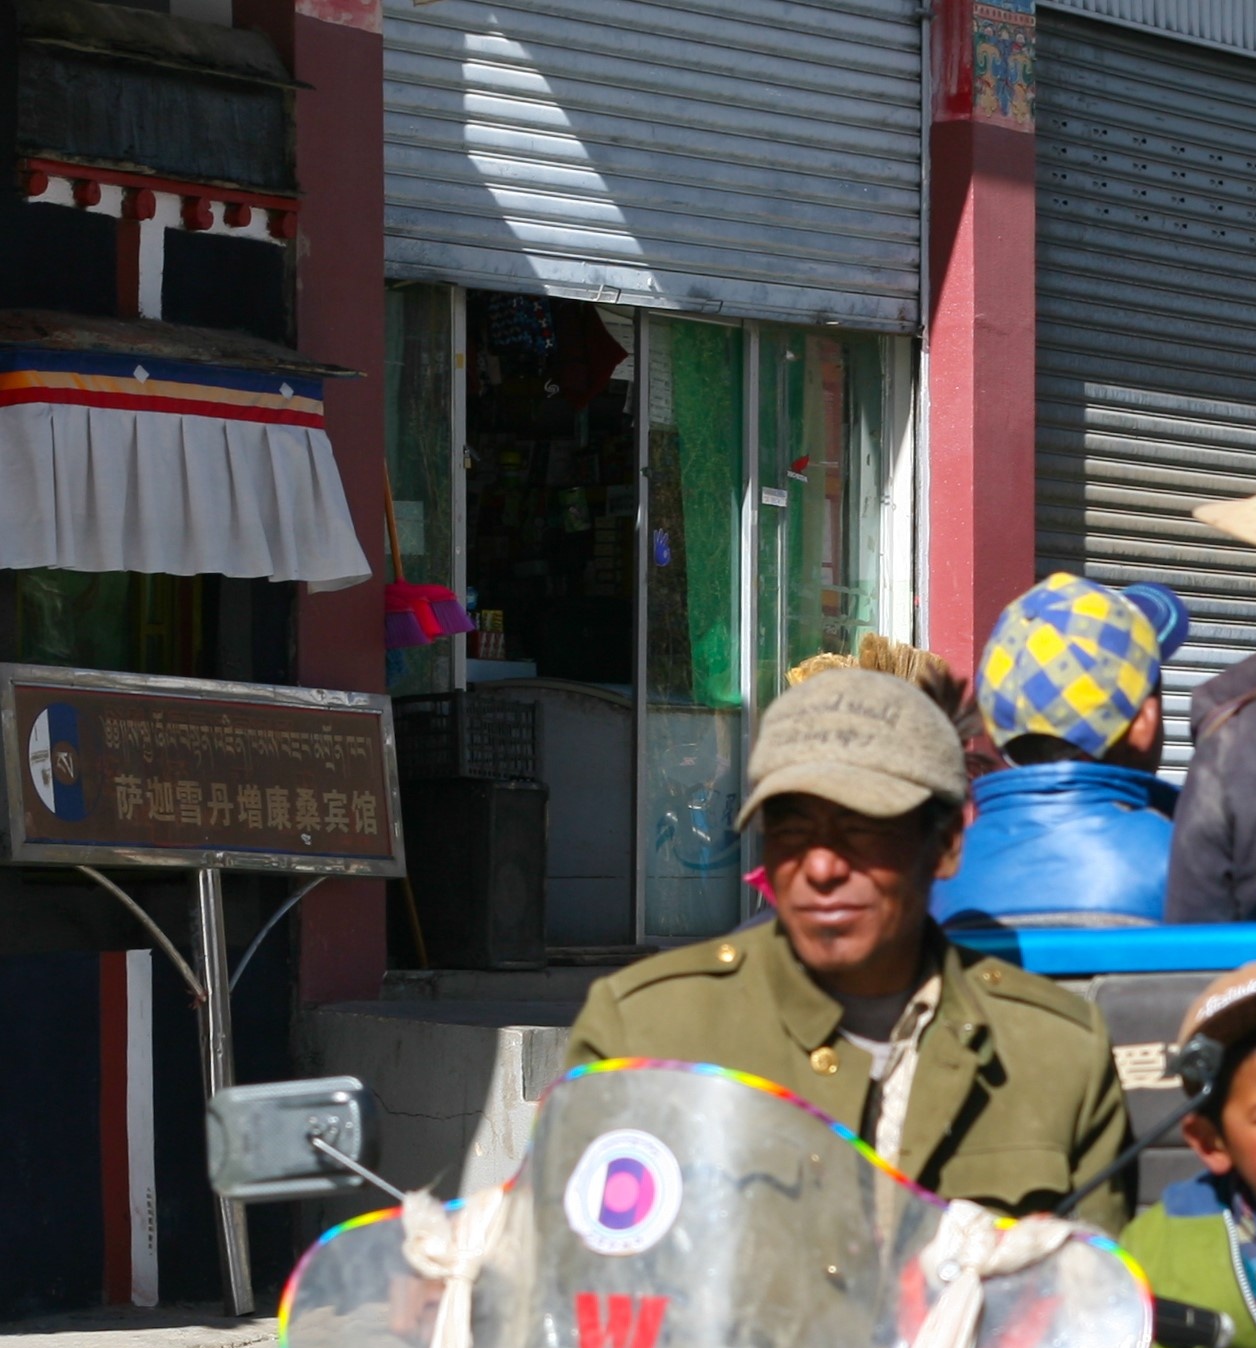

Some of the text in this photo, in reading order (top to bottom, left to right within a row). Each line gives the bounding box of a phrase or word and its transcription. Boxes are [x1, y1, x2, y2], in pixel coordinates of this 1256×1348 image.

[115, 773, 378, 836] 萨迦雪丹增康桑宾馆
